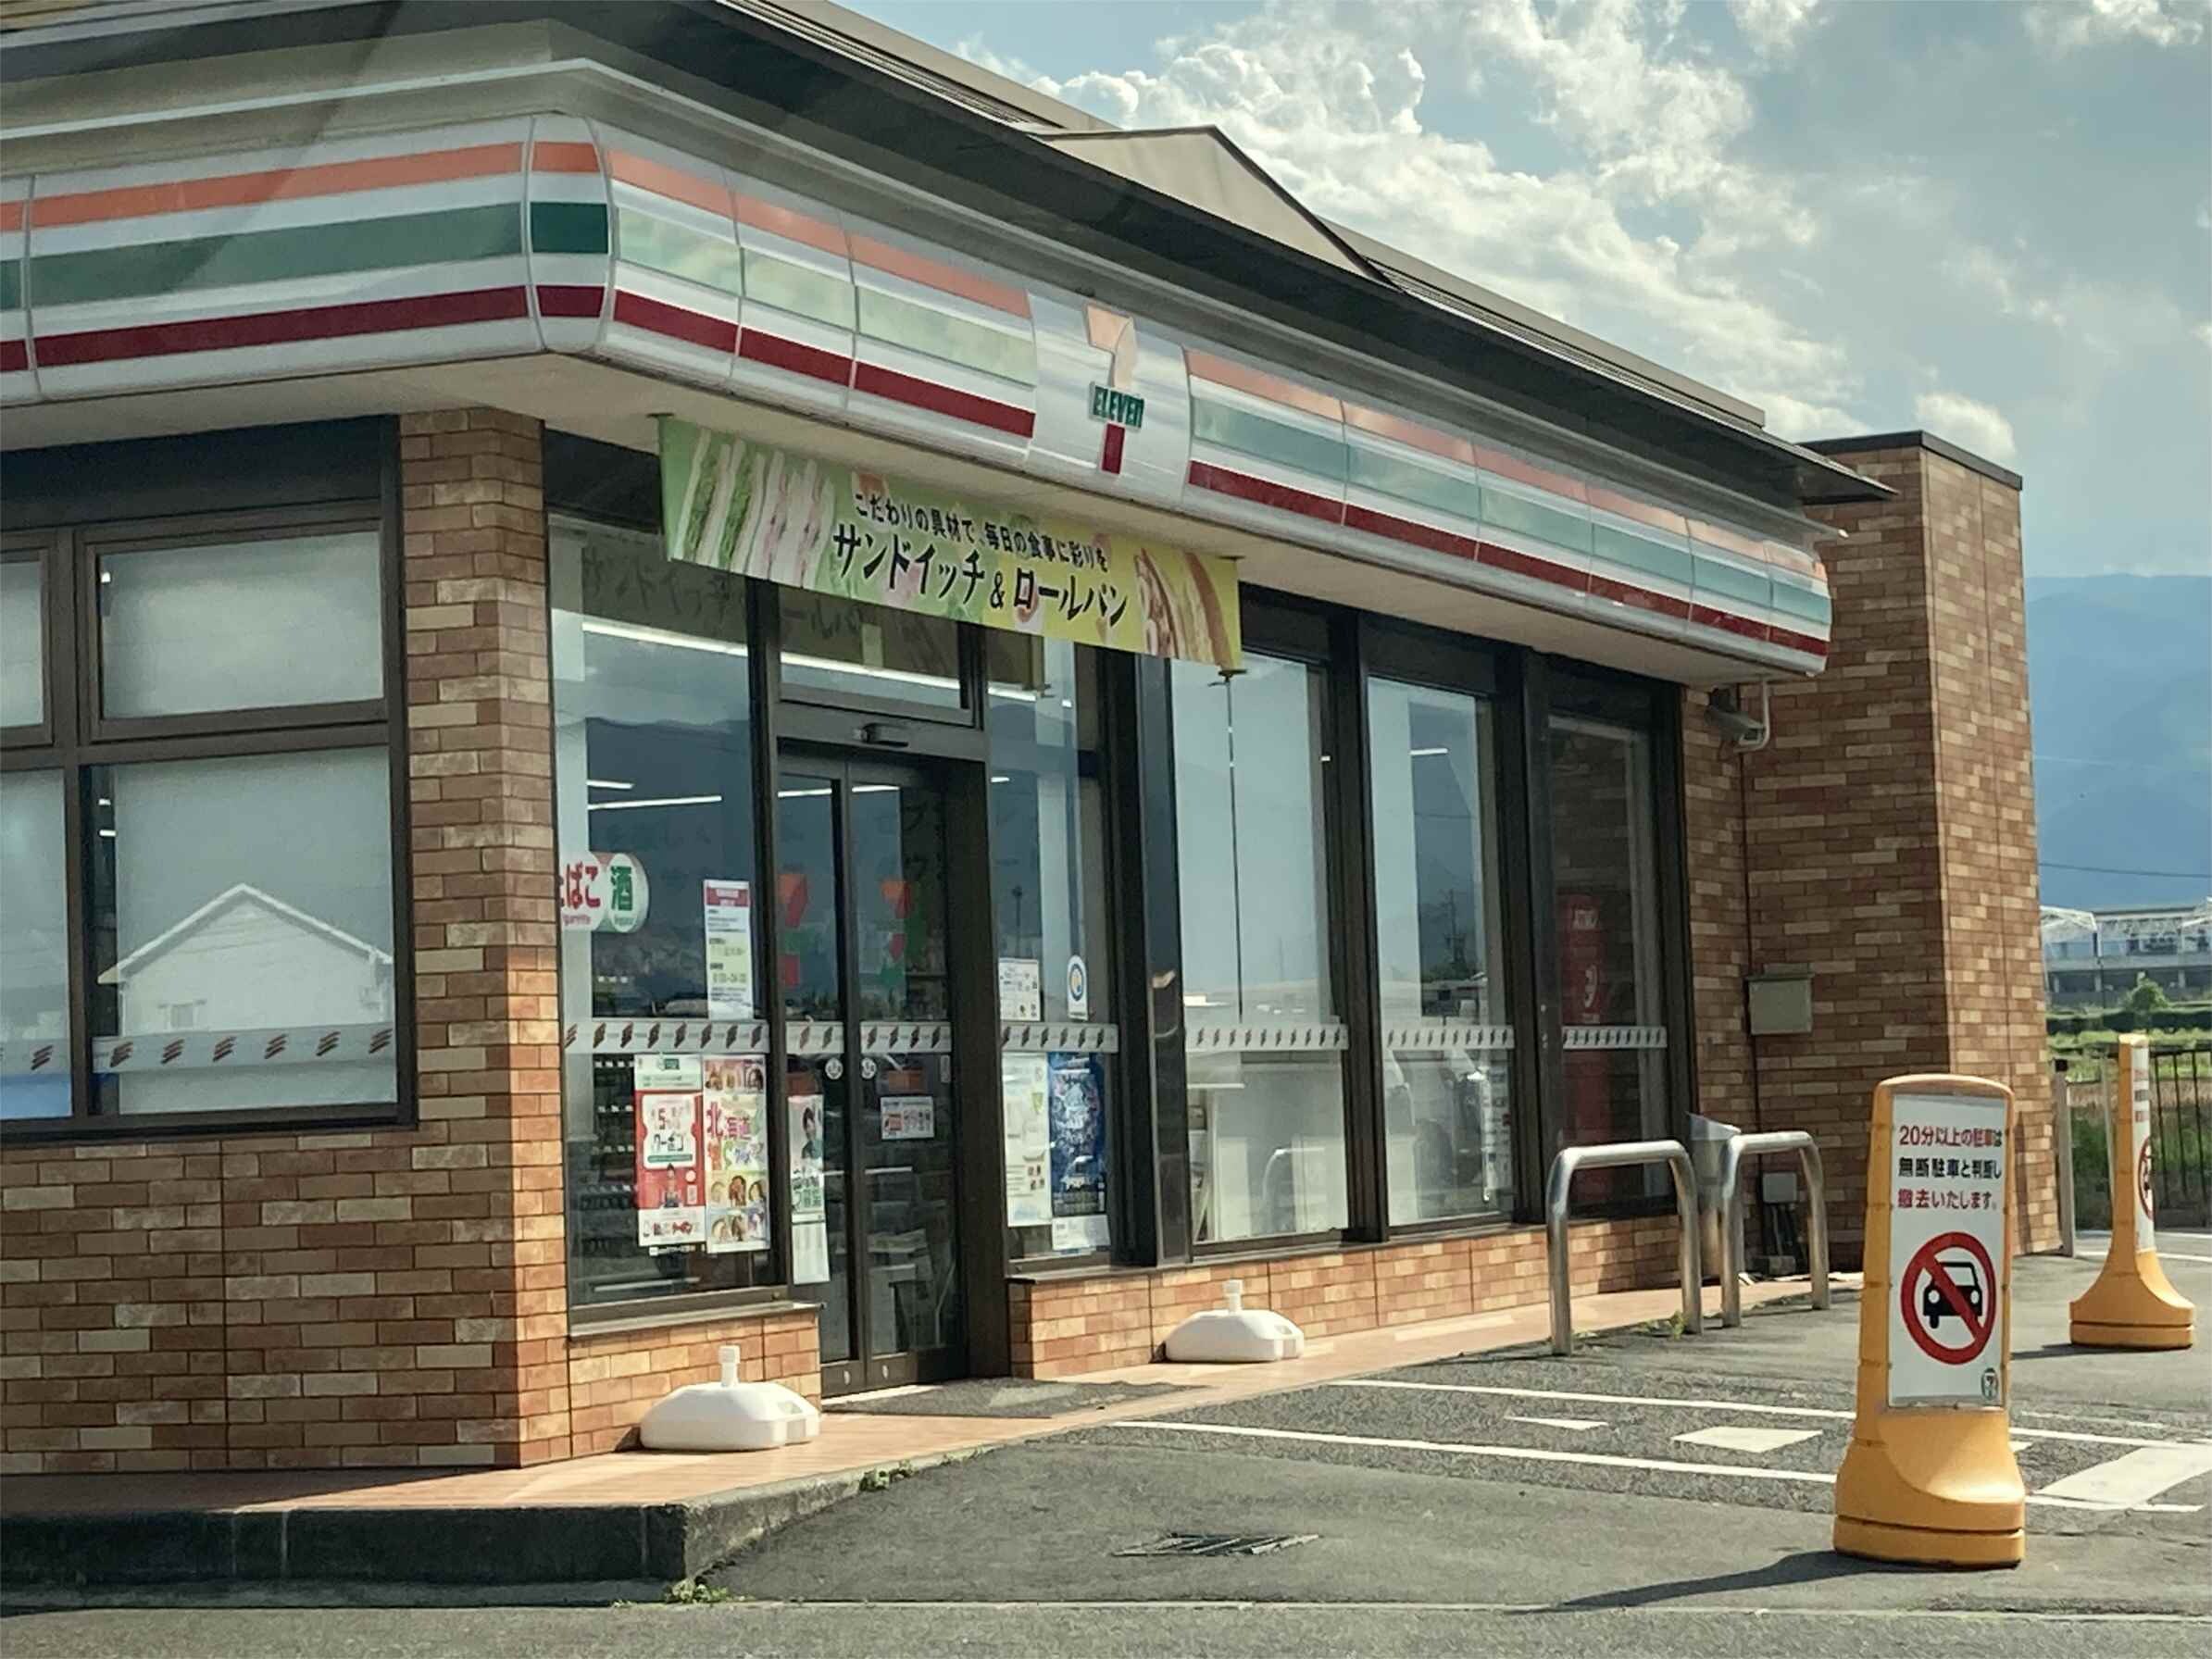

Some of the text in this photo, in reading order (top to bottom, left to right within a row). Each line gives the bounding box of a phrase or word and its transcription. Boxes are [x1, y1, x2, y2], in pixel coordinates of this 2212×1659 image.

[610, 866, 633, 911] 酒
[1898, 1156, 2002, 1179] 無断駐車と判断し
